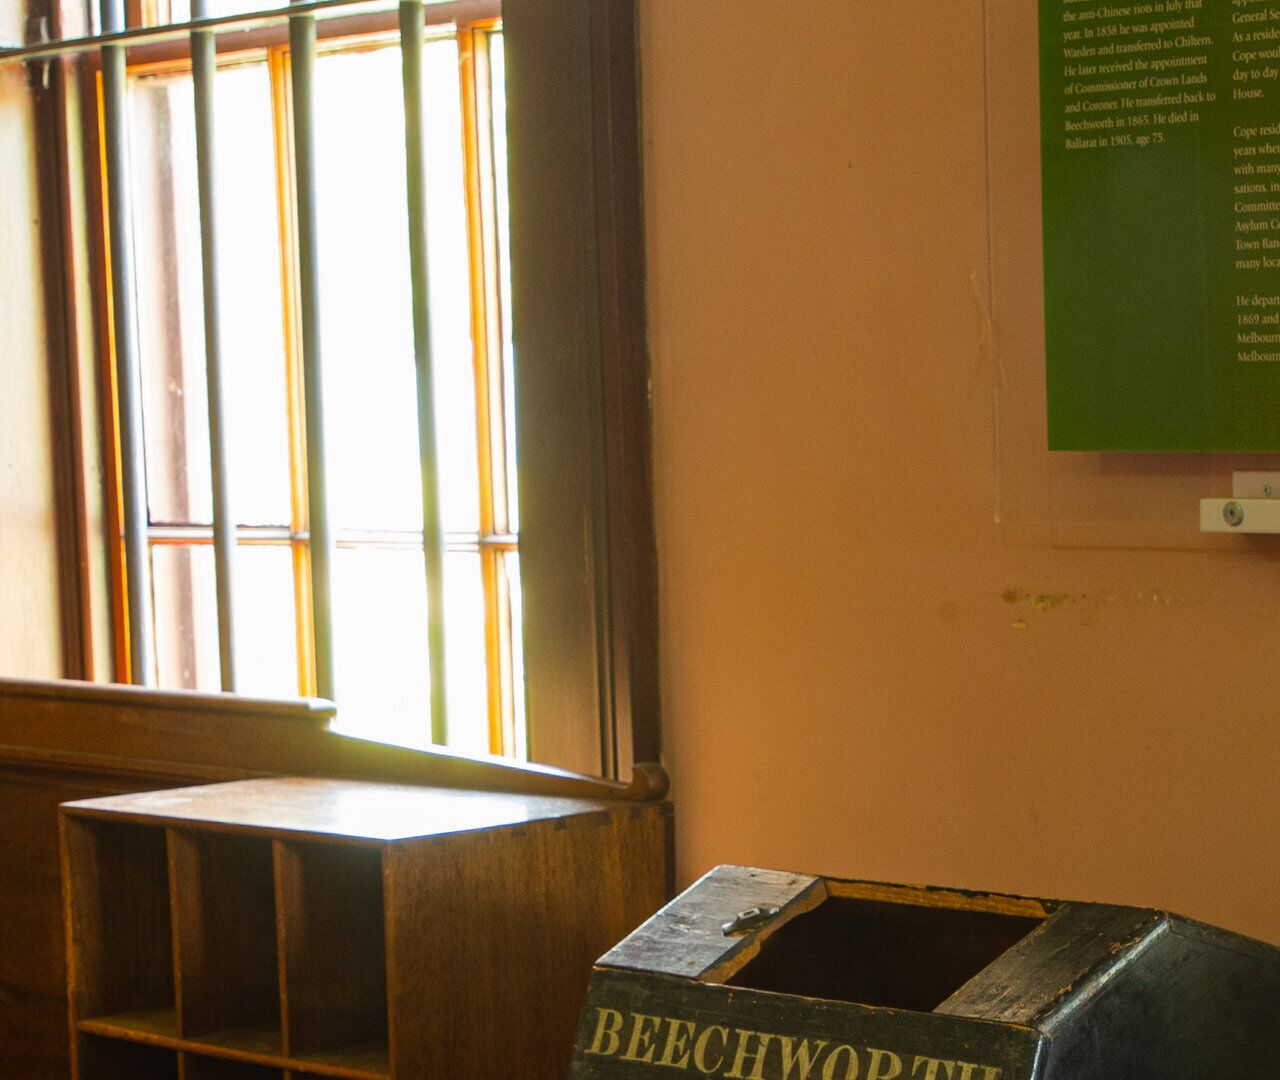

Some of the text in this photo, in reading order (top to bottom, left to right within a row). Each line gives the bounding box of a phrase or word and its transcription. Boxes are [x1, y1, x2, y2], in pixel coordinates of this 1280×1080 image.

[1234, 219, 1268, 233] Asylum
[1235, 238, 1260, 250] Town
[1236, 260, 1260, 272] many
[1238, 313, 1259, 325] 1869
[1262, 312, 1279, 325] and
